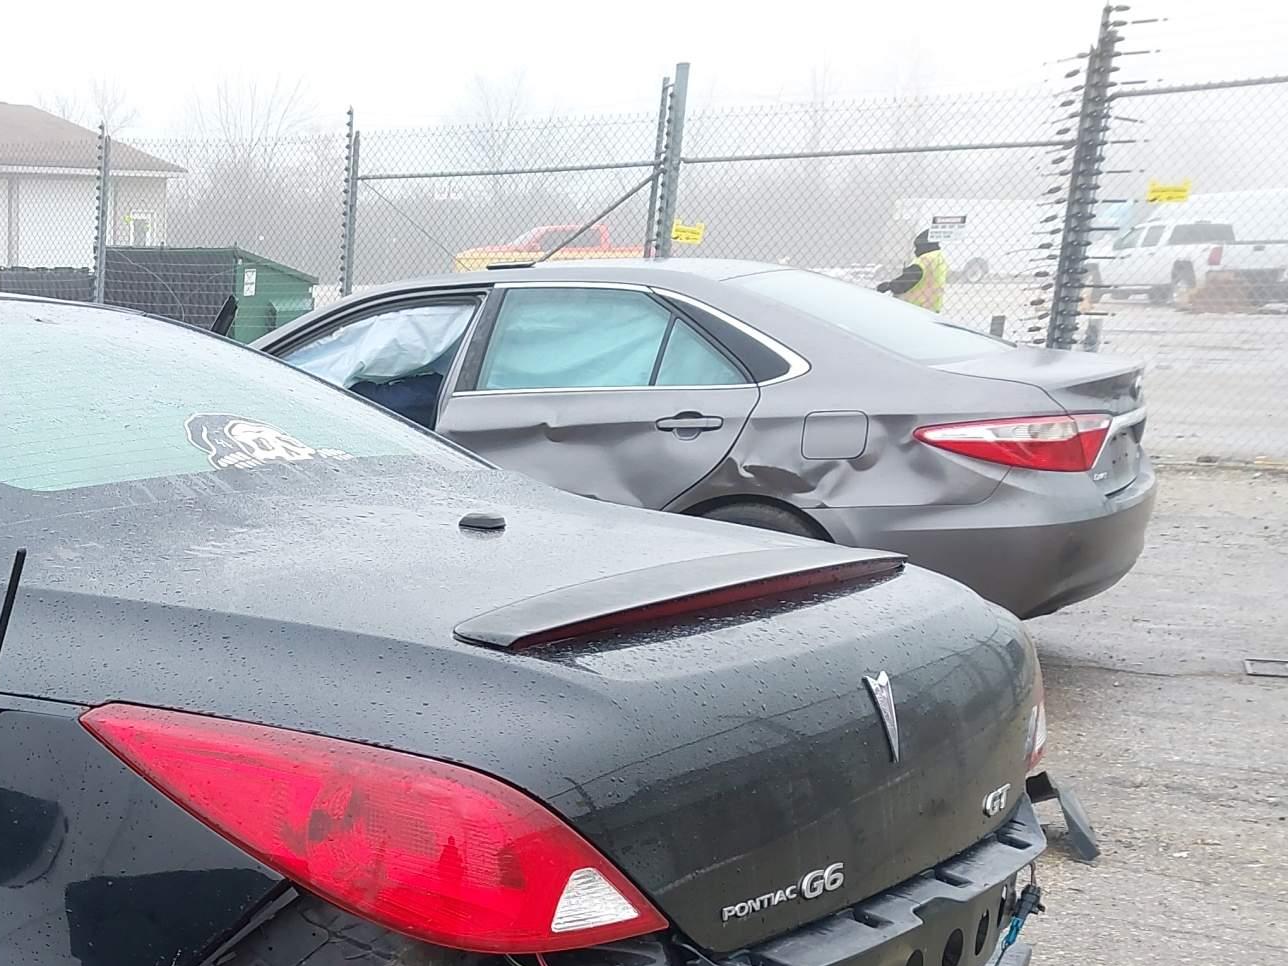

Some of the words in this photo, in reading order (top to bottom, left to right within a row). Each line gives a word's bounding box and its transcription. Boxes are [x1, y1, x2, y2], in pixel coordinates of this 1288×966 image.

[984, 783, 1011, 816] GT
[721, 885, 798, 921] PONTIAC
[800, 861, 845, 899] G6
